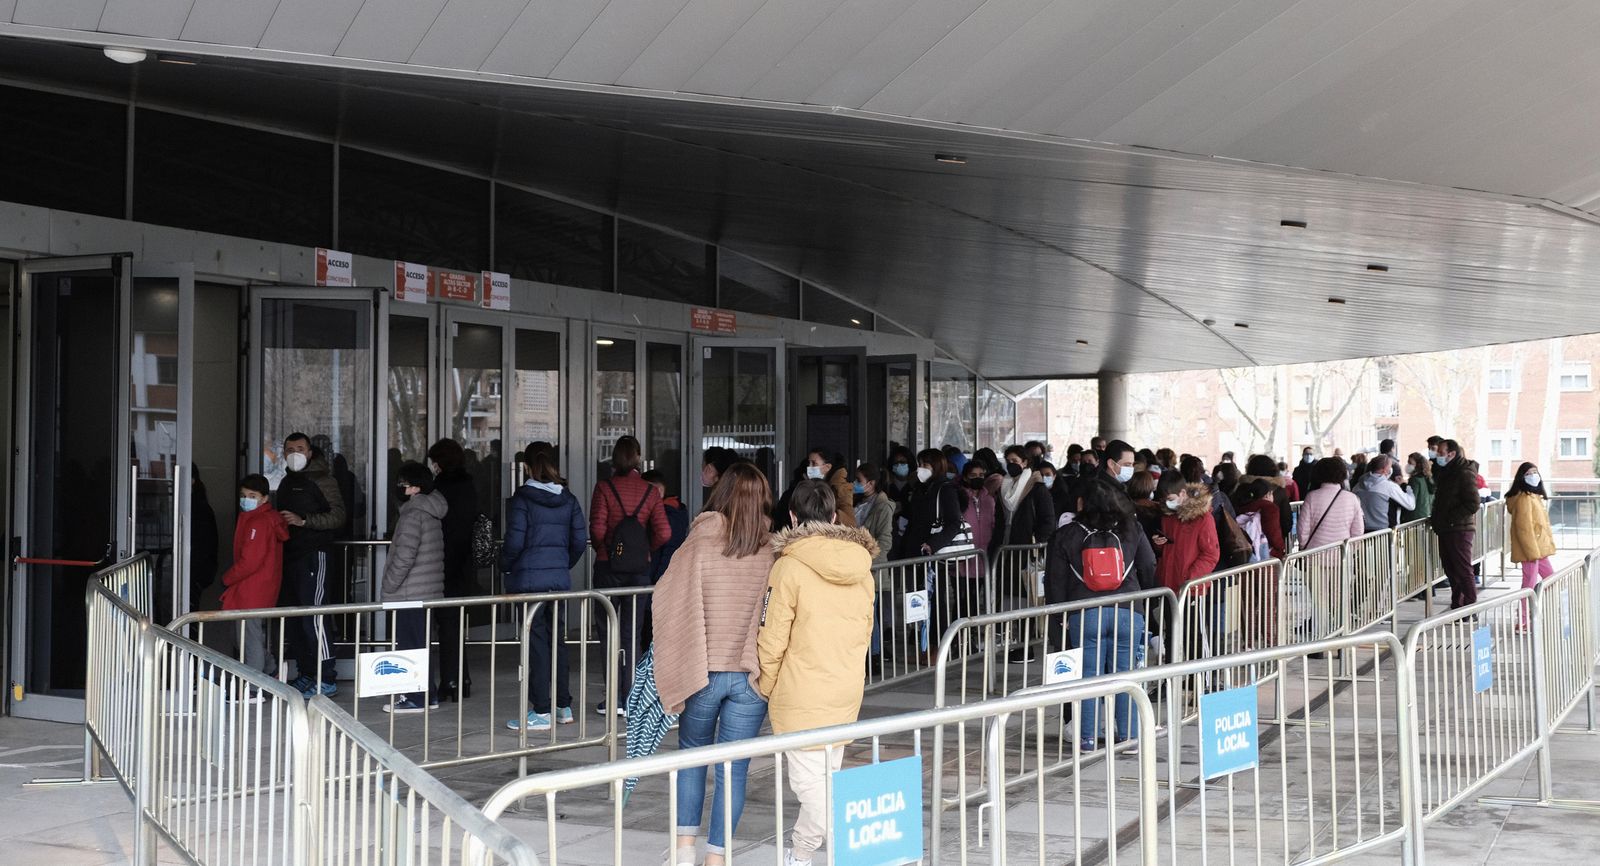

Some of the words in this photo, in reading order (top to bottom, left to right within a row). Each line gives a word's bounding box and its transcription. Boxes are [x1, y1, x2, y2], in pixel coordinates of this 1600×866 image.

[328, 259, 349, 269] ACCESO
[406, 271, 425, 281] ACCESO
[492, 280, 508, 288] ACCESO
[1215, 710, 1252, 735] POLICIA
[1217, 731, 1250, 755] LOCAL
[845, 790, 906, 823] POLICIA
[849, 818, 903, 849] LOCAL
